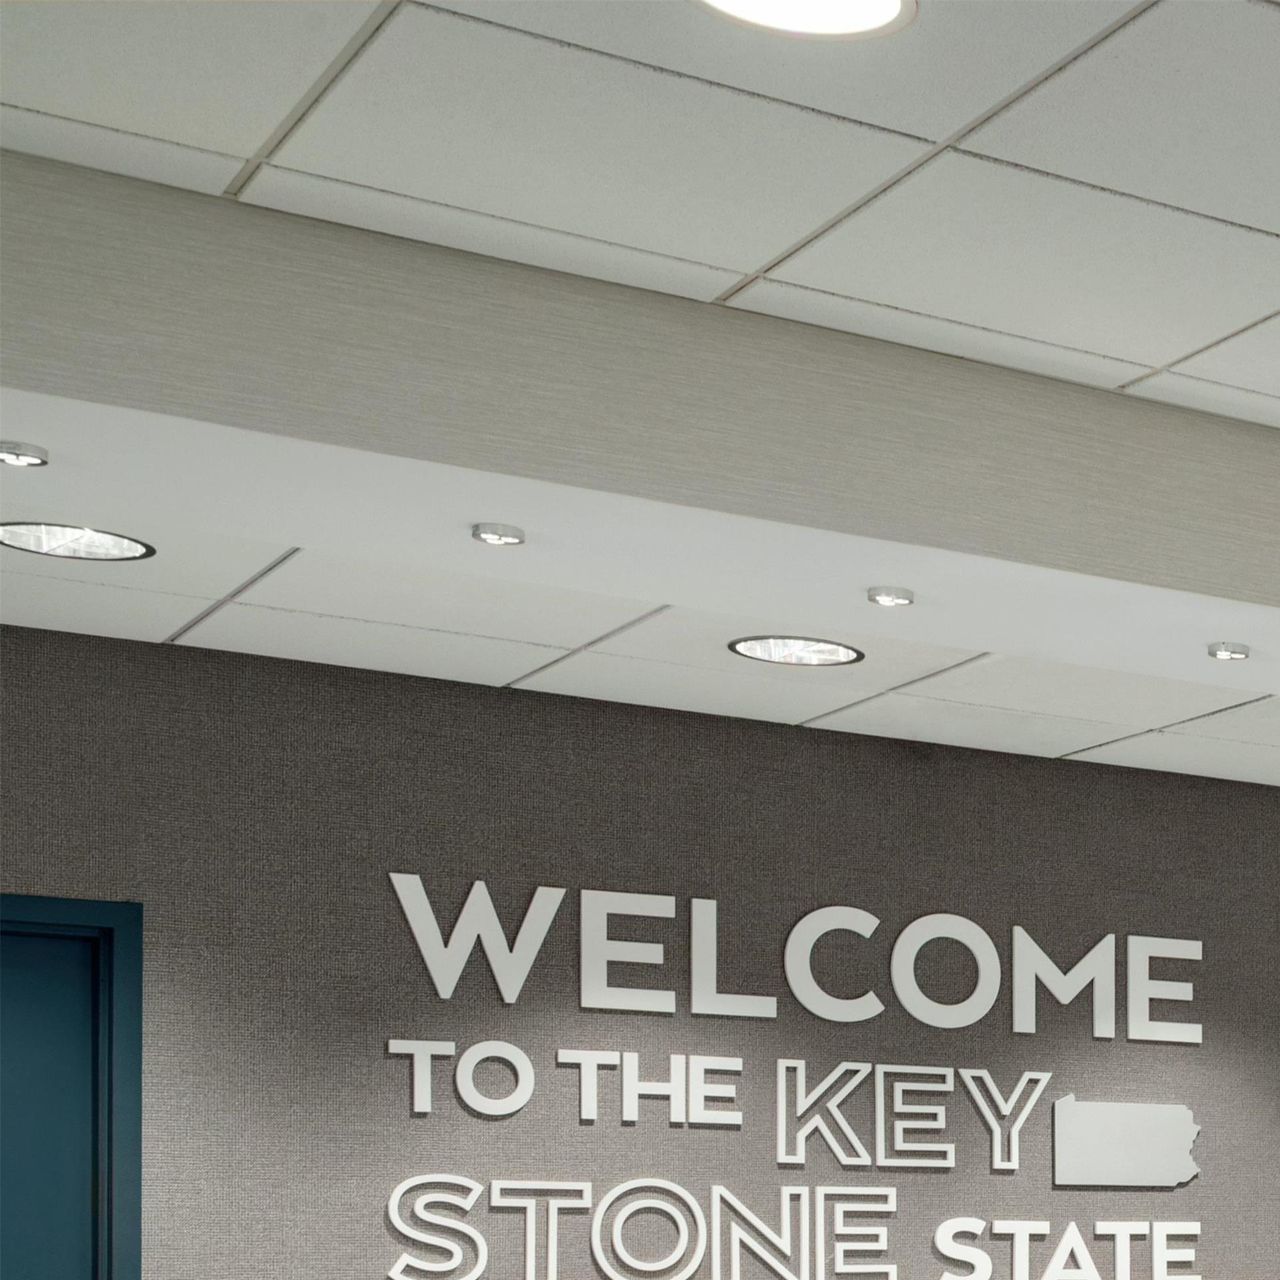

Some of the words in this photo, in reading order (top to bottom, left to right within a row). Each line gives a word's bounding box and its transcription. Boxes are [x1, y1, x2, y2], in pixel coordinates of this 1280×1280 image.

[388, 872, 1203, 1043] WELCOME
[388, 1039, 536, 1116] TO
[557, 1048, 743, 1125] THE
[776, 1058, 1053, 1170] KEY
